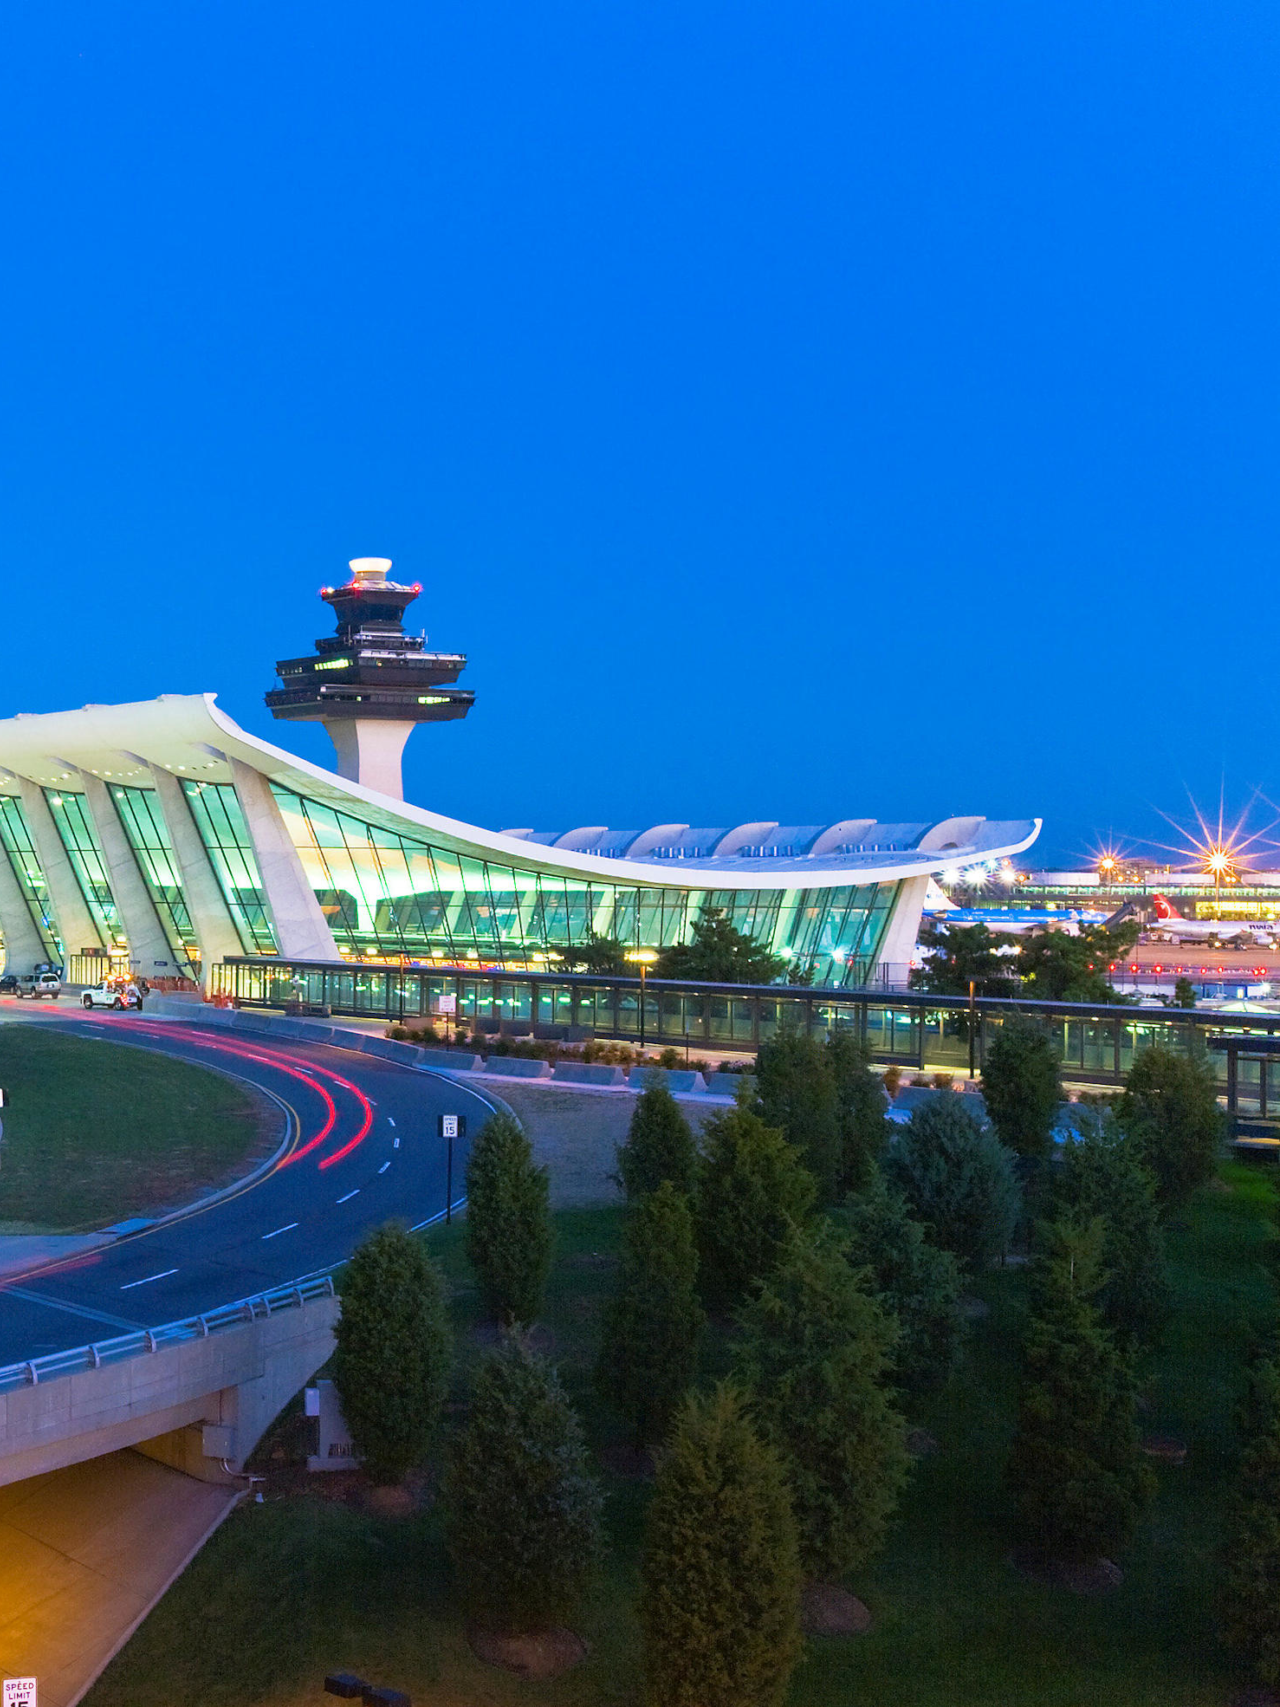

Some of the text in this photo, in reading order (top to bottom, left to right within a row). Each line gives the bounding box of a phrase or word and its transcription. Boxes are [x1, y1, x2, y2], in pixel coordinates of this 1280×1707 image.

[445, 1126, 455, 1135] 15
[6, 1682, 34, 1691] SPEED
[8, 1691, 30, 1700] LIMIT
